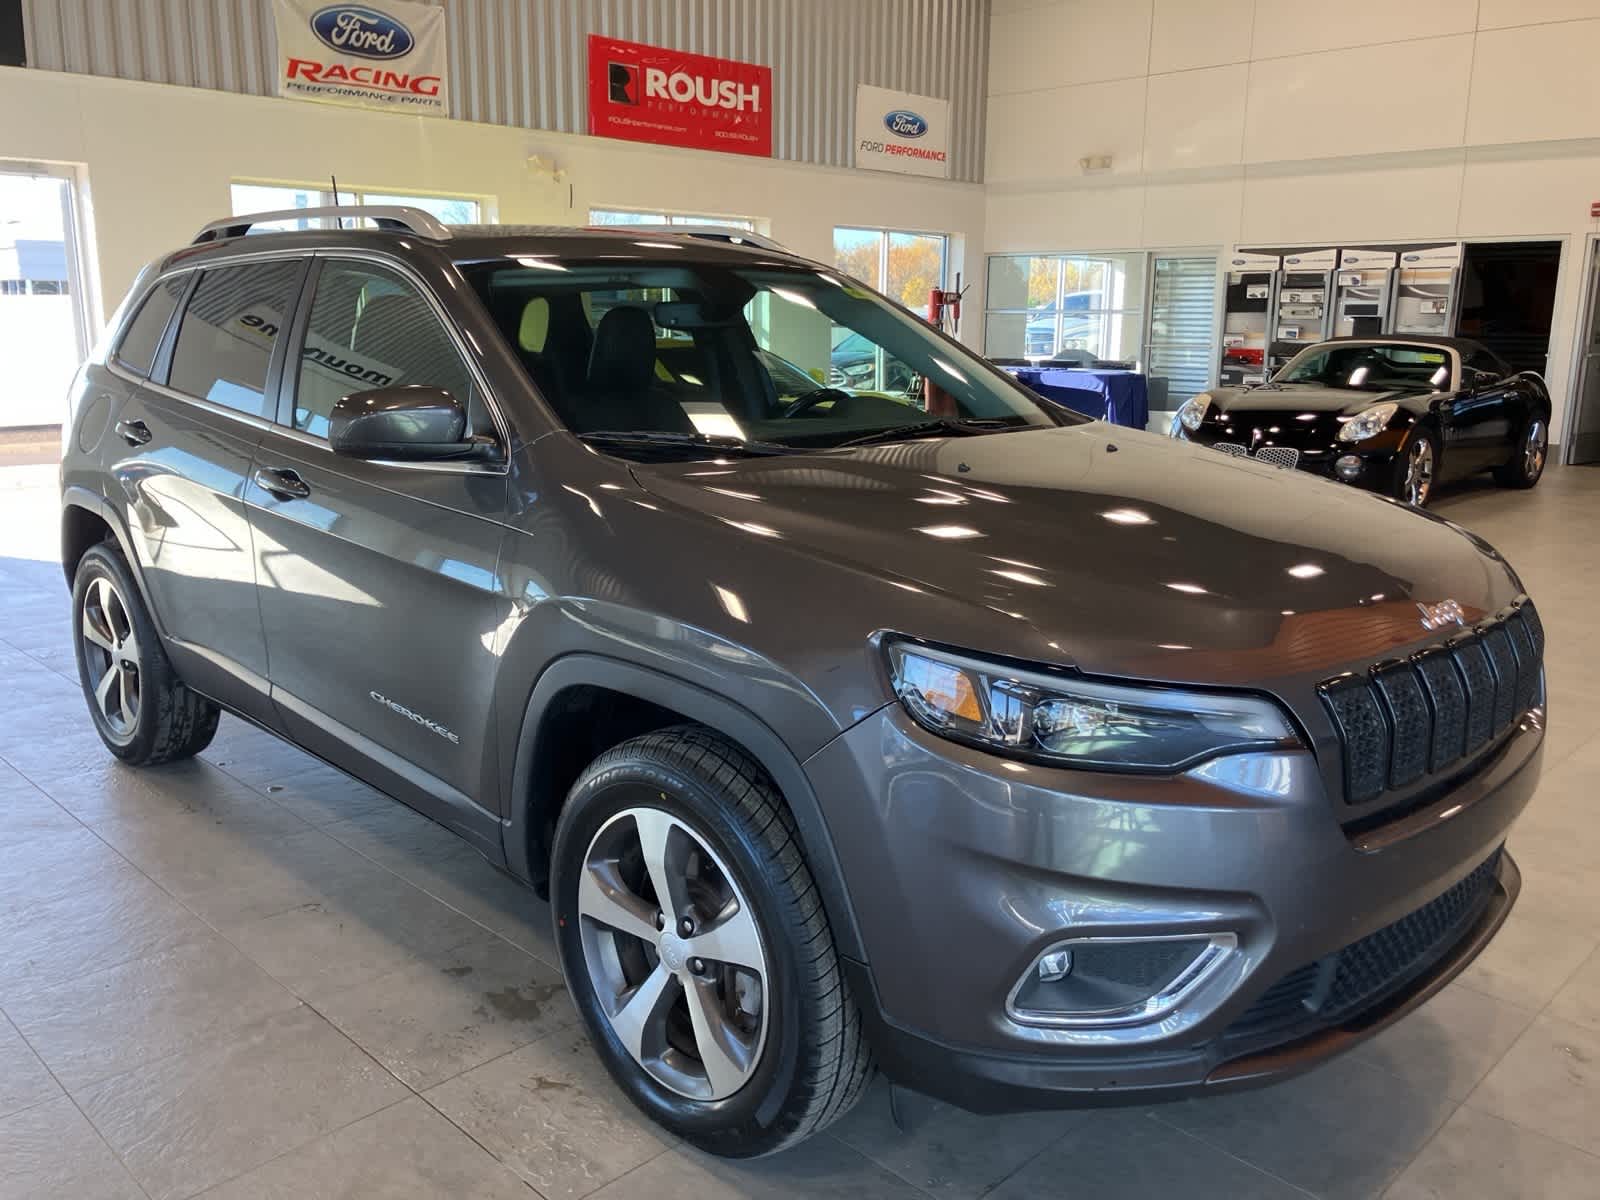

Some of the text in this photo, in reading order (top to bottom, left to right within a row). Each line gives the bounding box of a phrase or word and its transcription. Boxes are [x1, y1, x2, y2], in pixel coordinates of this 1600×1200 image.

[332, 12, 394, 53] Ford
[286, 82, 442, 107] PERFORMANCE PARTS
[287, 58, 440, 96] RACING
[646, 68, 760, 112] ROUSH
[892, 113, 920, 134] Ford
[860, 141, 946, 161] FORD PERFORMANCE
[369, 690, 460, 745] CHEROKEE
